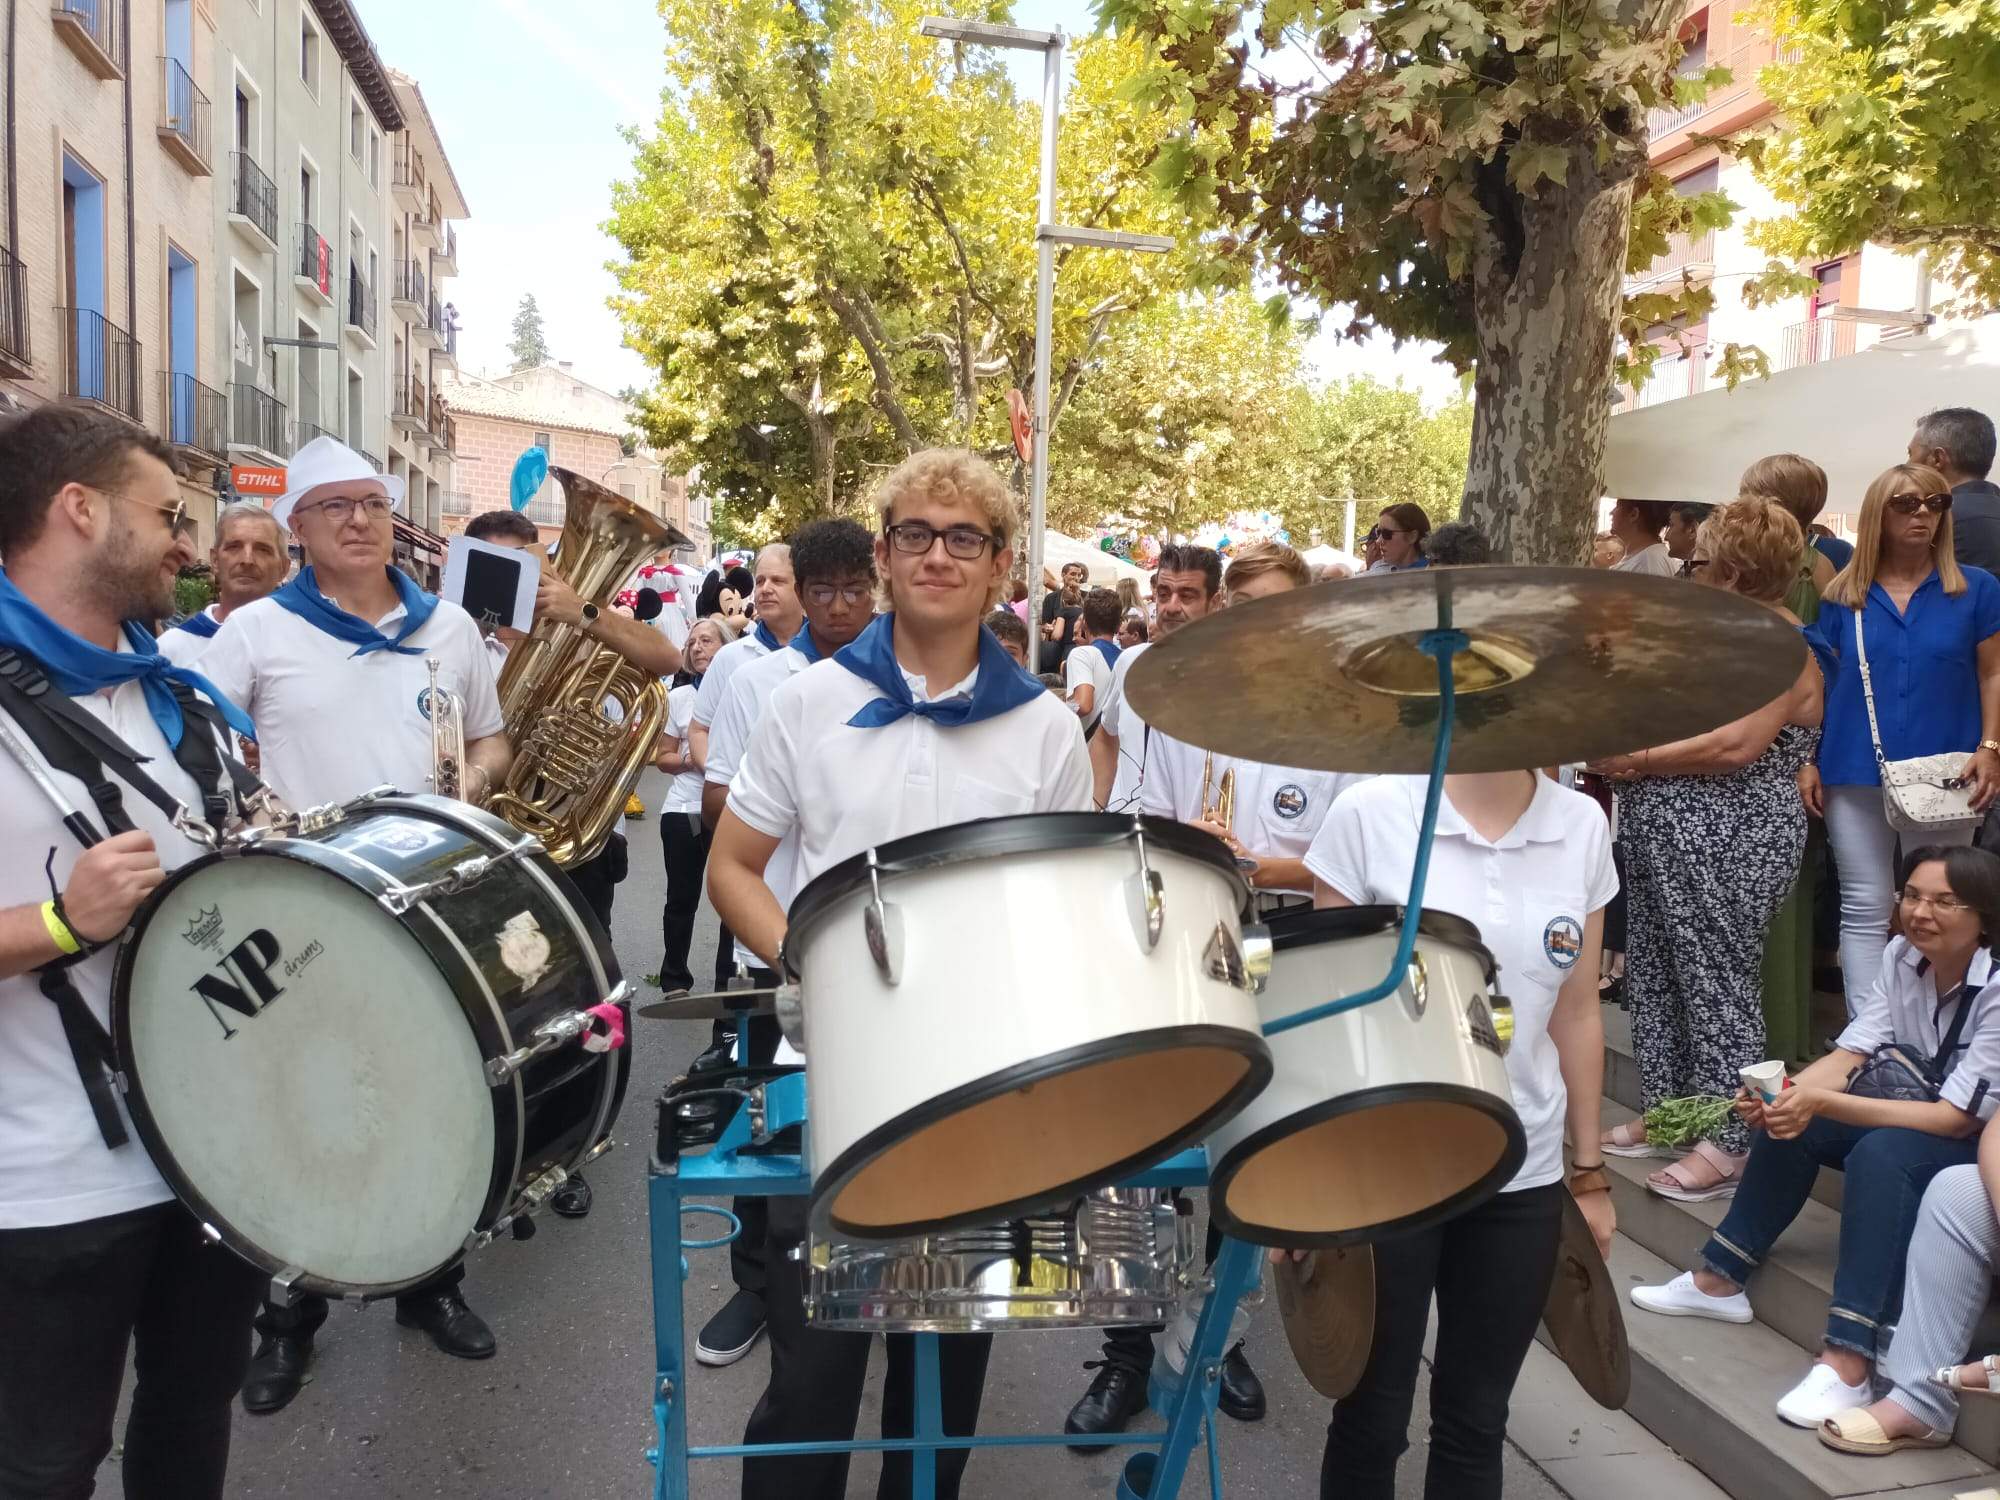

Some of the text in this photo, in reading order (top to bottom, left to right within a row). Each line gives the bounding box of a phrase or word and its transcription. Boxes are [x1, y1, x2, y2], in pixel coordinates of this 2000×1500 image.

[237, 473, 281, 487] STIHL
[191, 914, 219, 941] REMO
[189, 928, 324, 1040] NP drums
